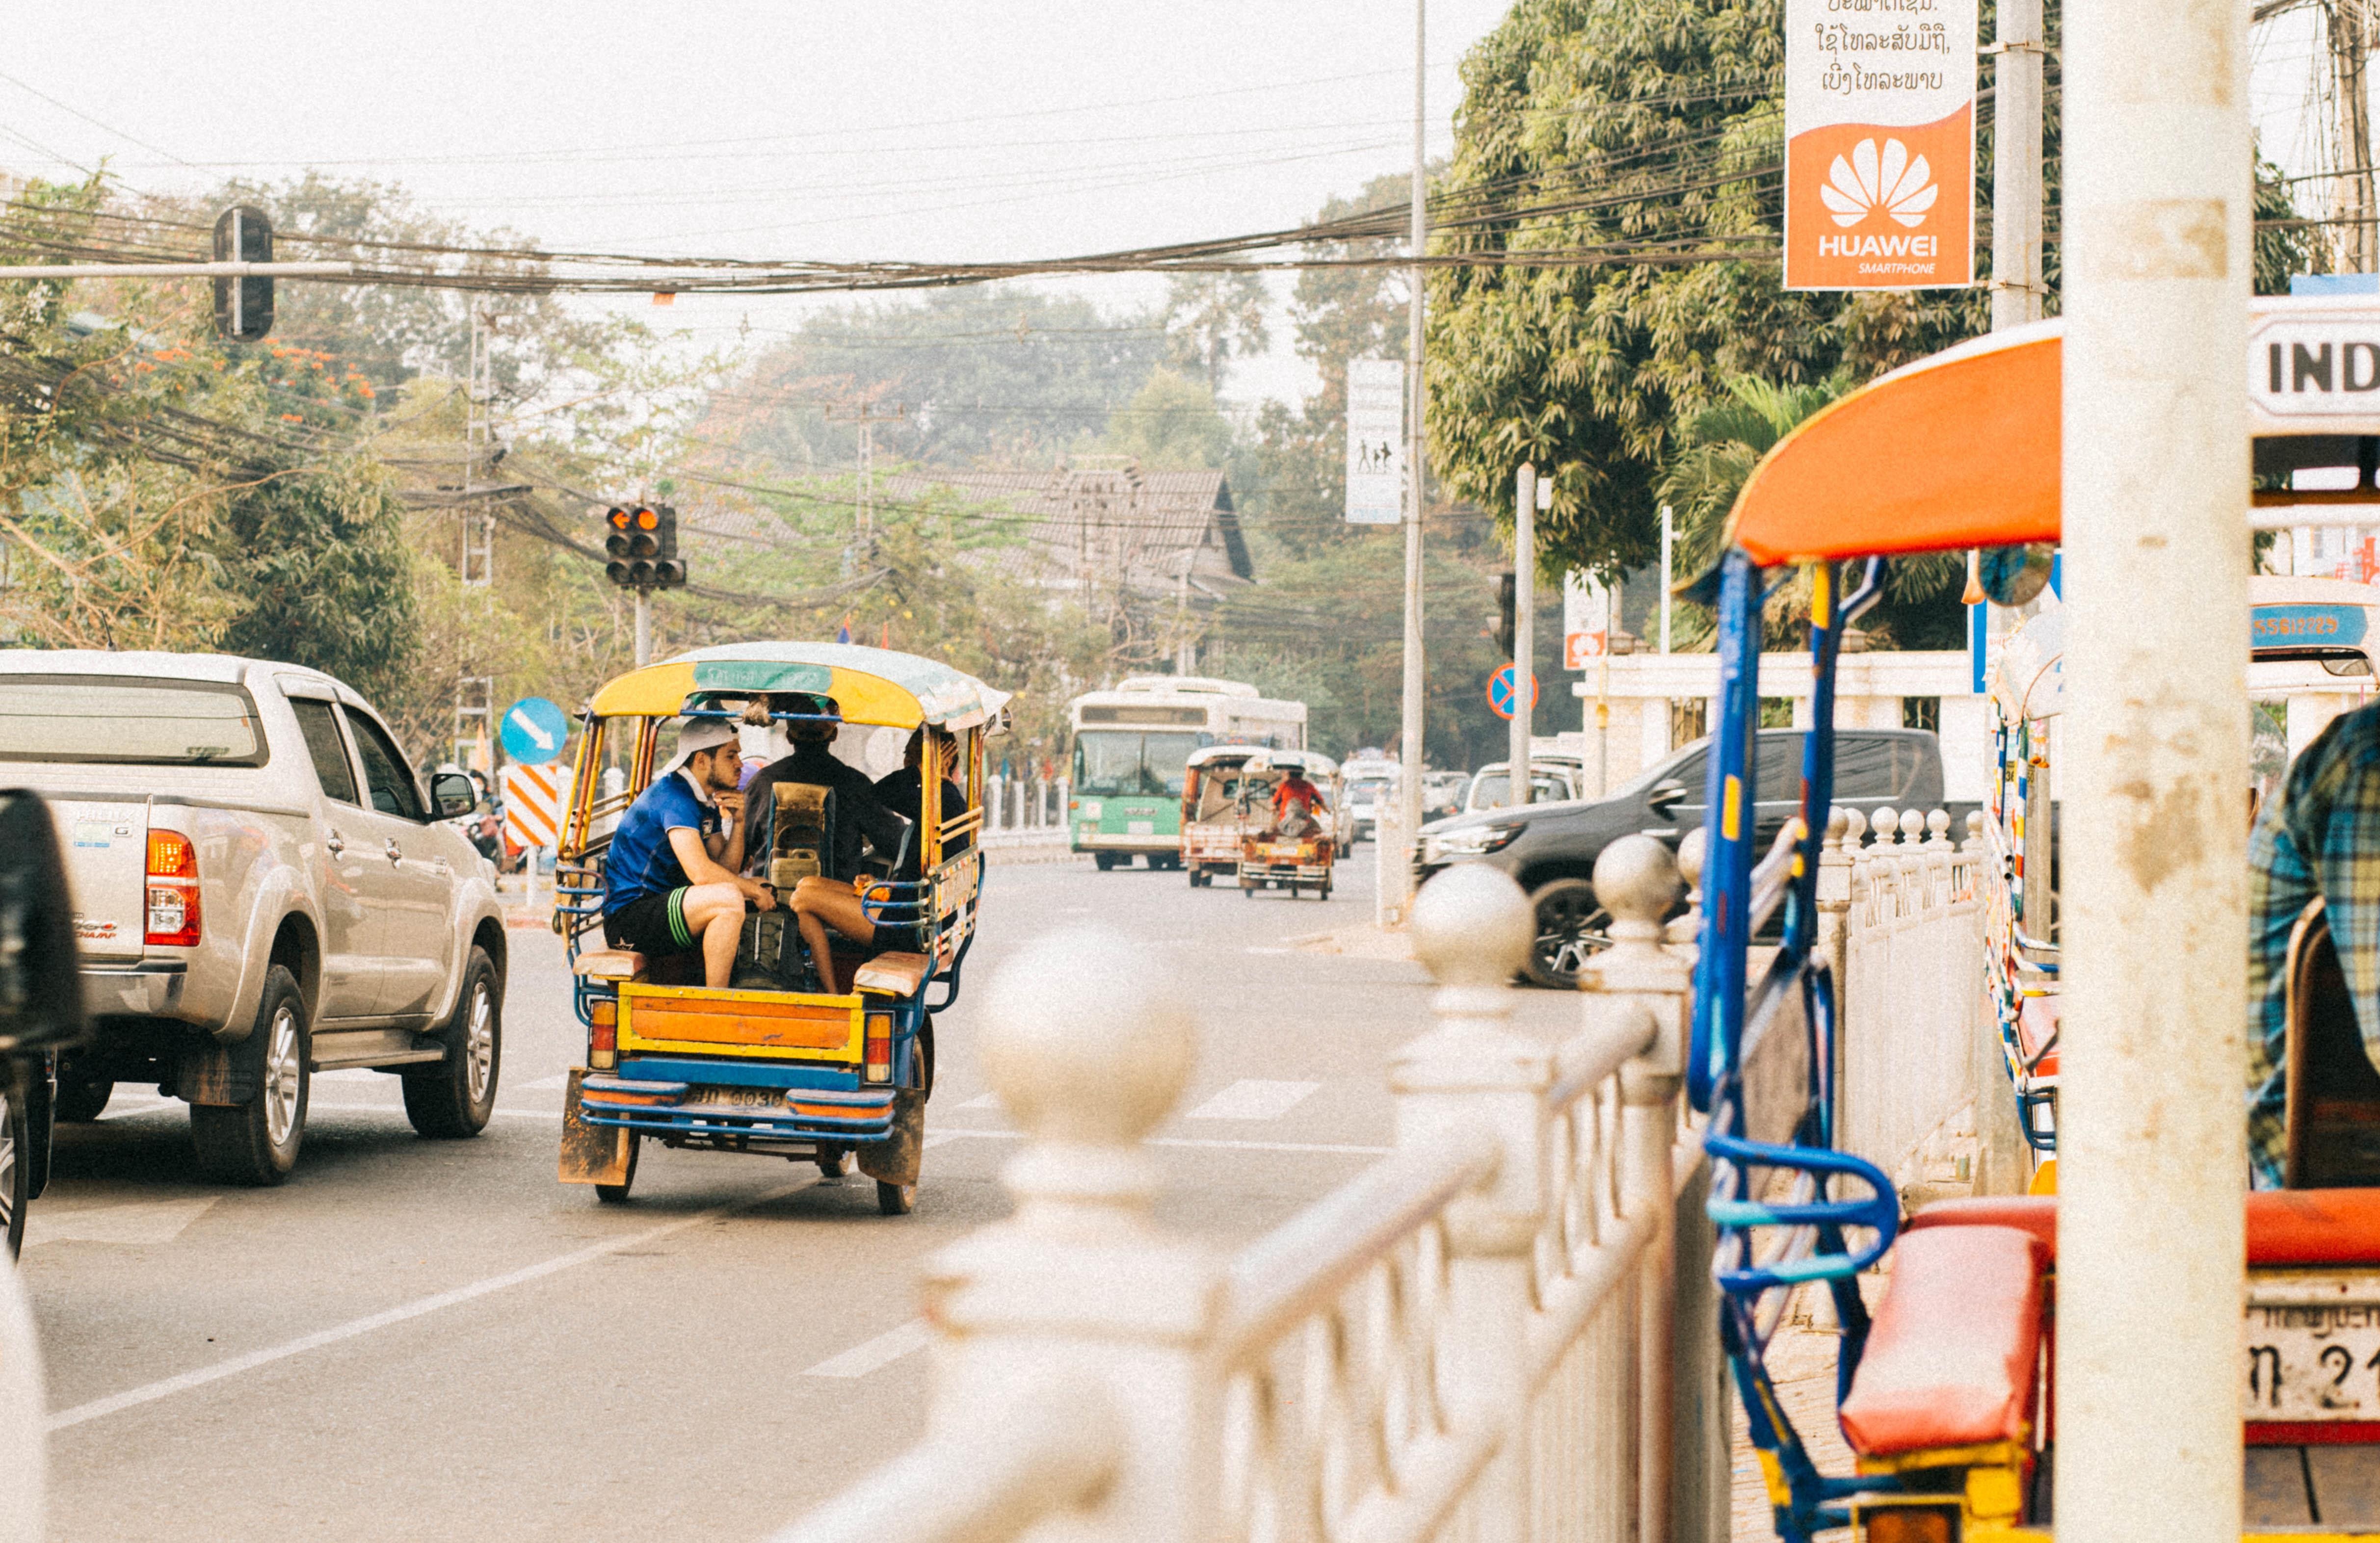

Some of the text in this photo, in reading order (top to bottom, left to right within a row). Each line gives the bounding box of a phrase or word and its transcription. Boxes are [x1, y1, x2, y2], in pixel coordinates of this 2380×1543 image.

[1819, 235, 1937, 257] HUAWEI
[1858, 262, 1935, 274] SMARTPHONE
[2269, 342, 2380, 393] IND
[113, 826, 131, 836] G
